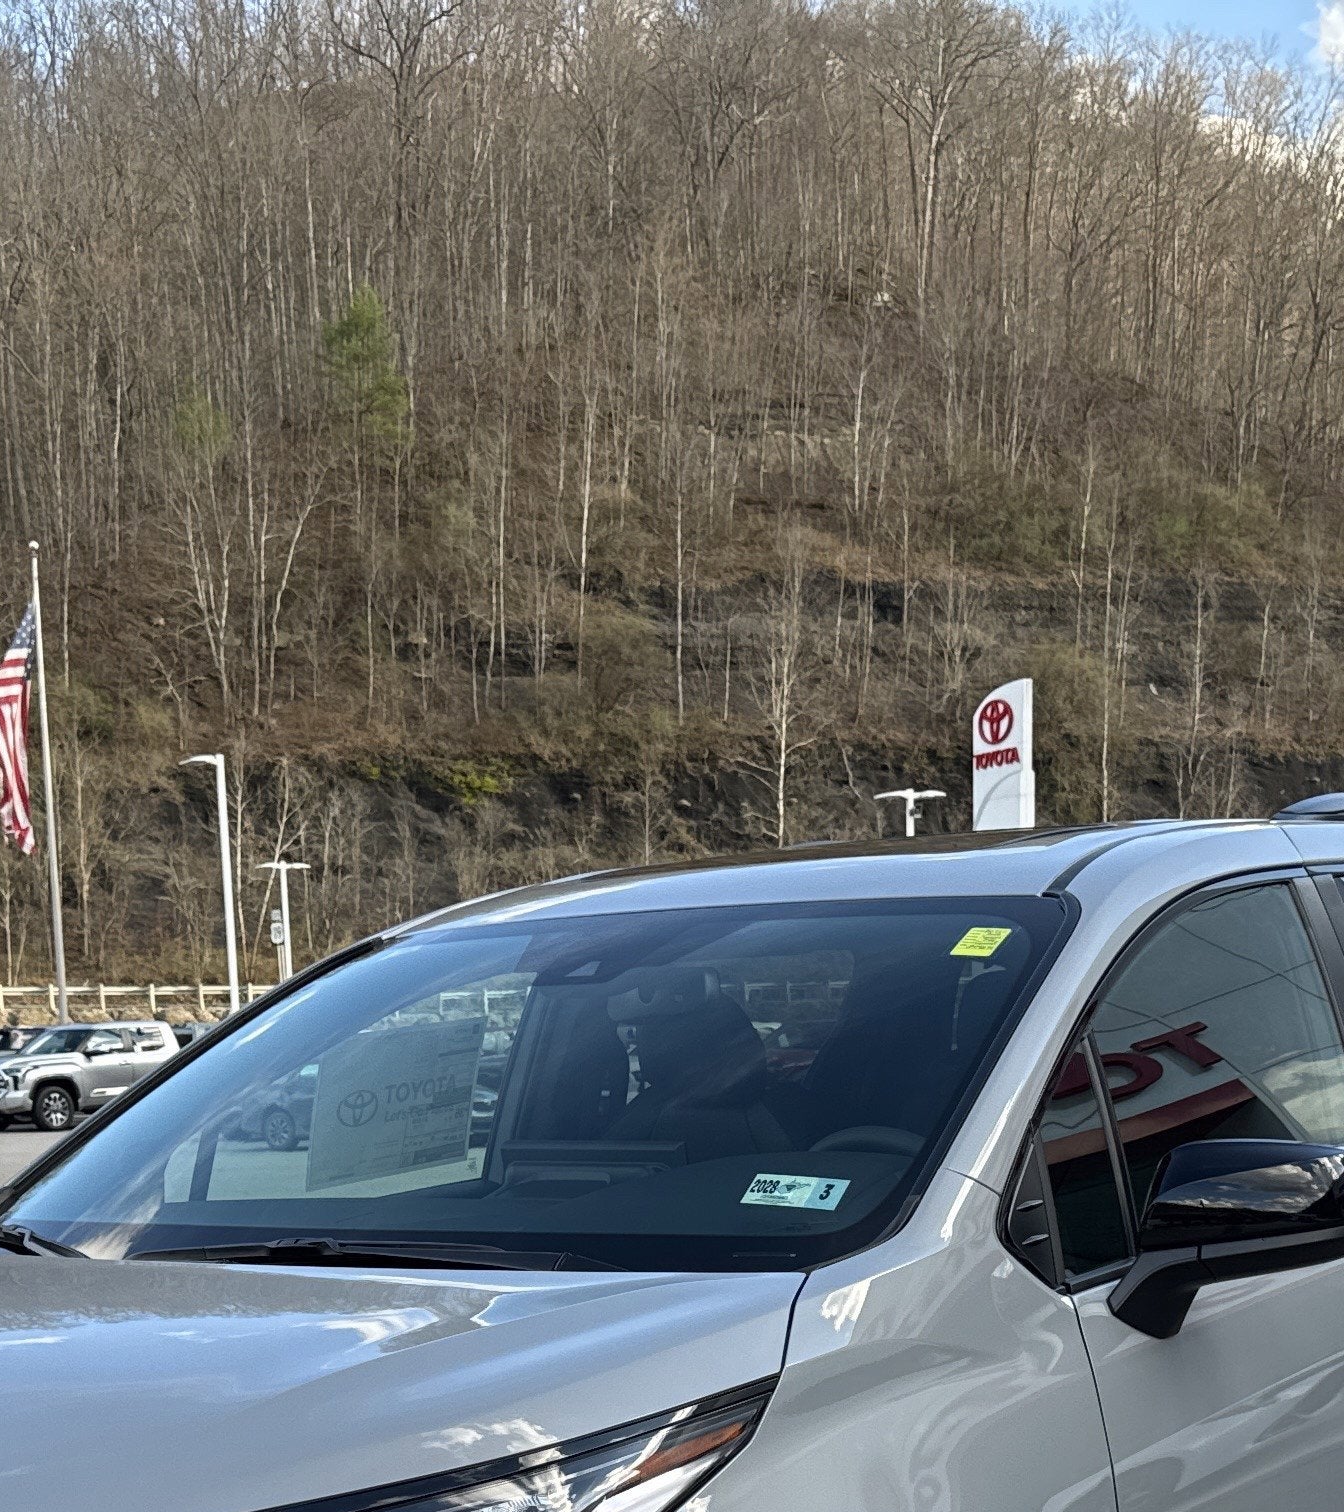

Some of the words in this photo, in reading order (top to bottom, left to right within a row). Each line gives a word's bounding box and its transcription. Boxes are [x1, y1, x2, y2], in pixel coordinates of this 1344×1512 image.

[974, 747, 1020, 770] TOYOTA
[385, 1074, 456, 1104] TOYOTA
[749, 1179, 781, 1194] 2028
[819, 1184, 836, 1200] 3
